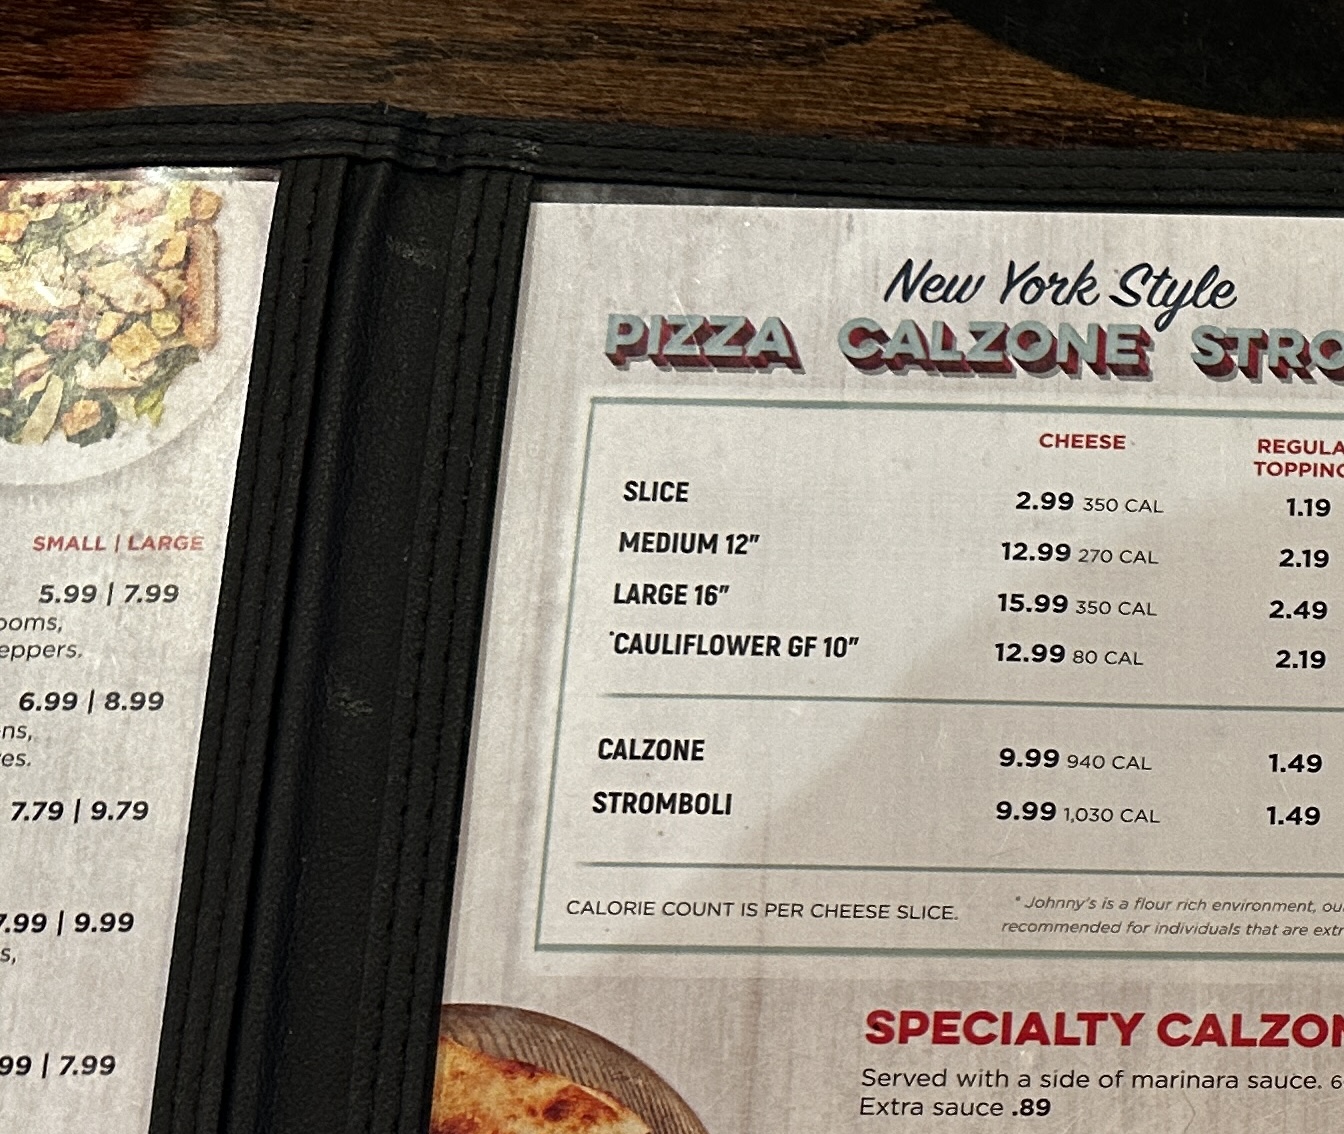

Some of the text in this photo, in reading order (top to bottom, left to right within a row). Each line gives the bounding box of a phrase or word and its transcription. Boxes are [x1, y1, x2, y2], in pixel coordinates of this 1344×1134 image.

[884, 258, 1238, 332] New York Style
[605, 313, 805, 375] PIZZA
[837, 316, 1155, 382] CALZONE
[1039, 433, 1126, 449] CHEESE
[623, 480, 689, 502] SLICE
[1016, 491, 1164, 513] 2.99 350 CAL
[1287, 498, 1331, 517] 1.19
[33, 536, 106, 551] SMALL
[128, 535, 204, 551] LARGE
[619, 532, 718, 554] MEDIUM
[1002, 542, 1159, 564] 12.99 270 CAL
[788, 636, 817, 657] GF
[995, 643, 1143, 665] 12.99 80 CAL
[598, 738, 705, 761] CALZONE
[1000, 748, 1152, 770] 9.99 940 CAL
[567, 901, 958, 920] CALORIE COUNT IS PER CHEESE SLICE.
[1025, 897, 1096, 911] Johnny's
[1102, 898, 1113, 909] is
[1119, 900, 1128, 909] a
[1134, 898, 1172, 910] flour
[1177, 899, 1206, 910] rich
[1212, 901, 1316, 913] environment,
[866, 1010, 1145, 1046] SPECIALTY
